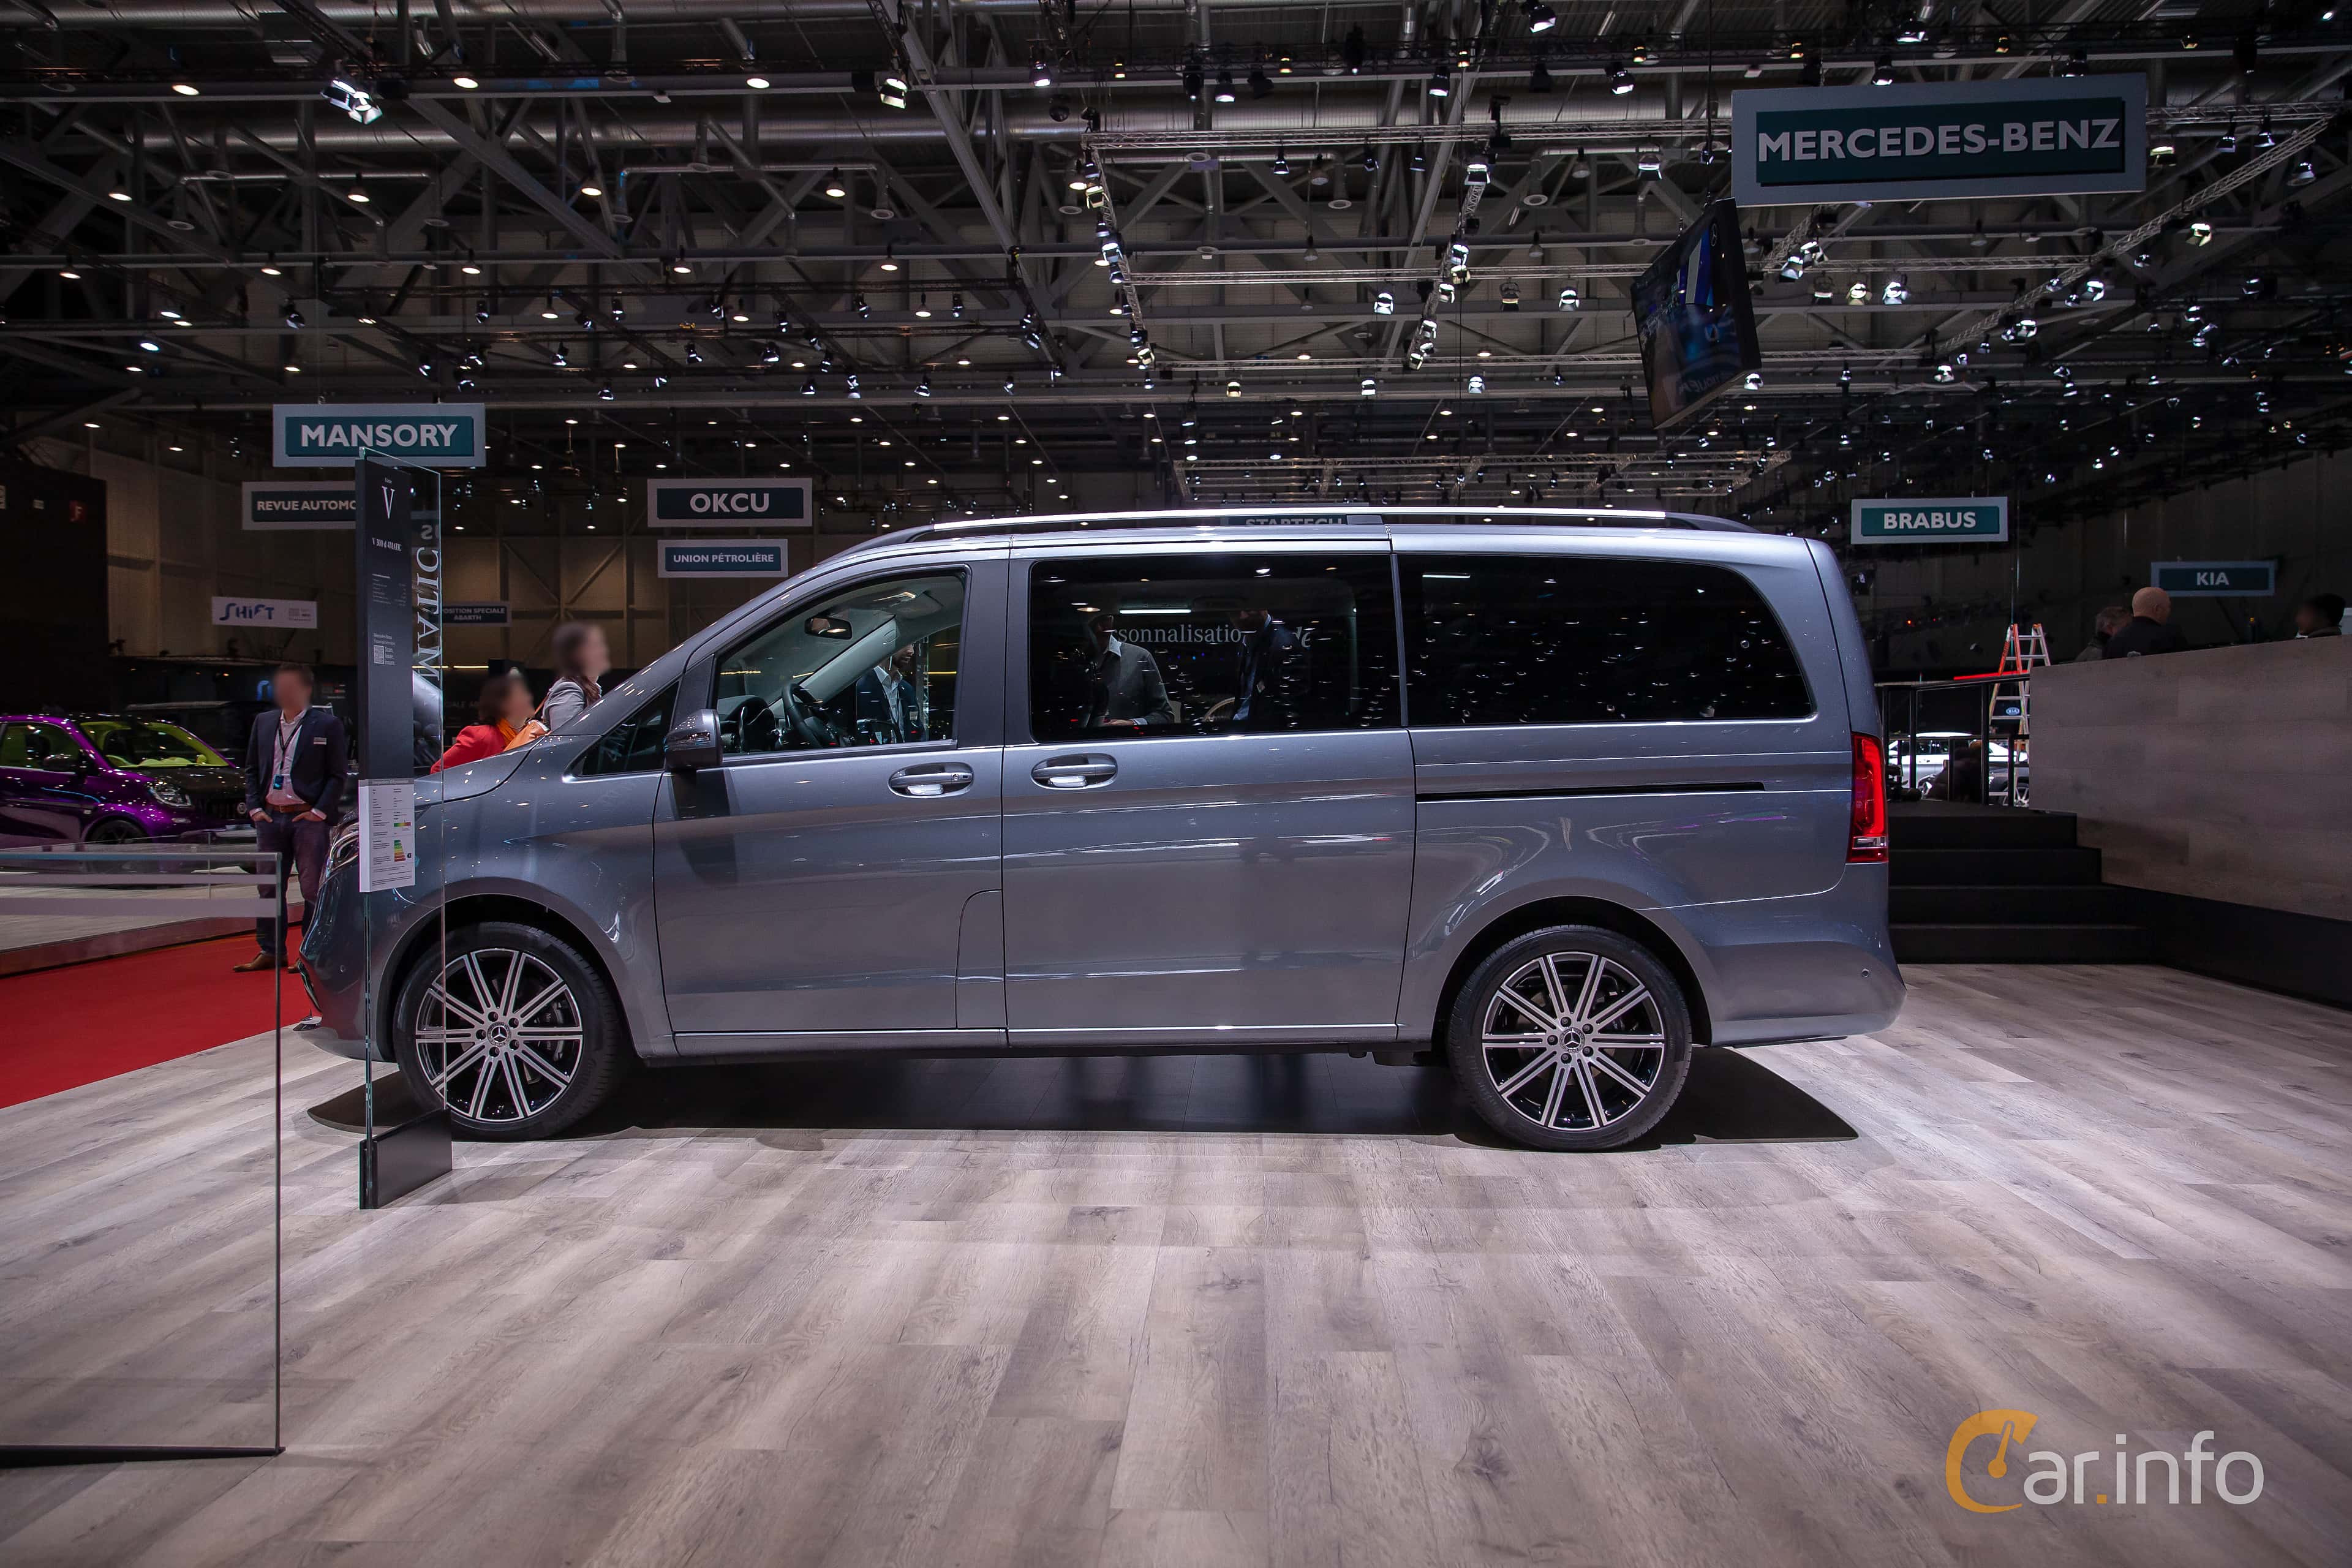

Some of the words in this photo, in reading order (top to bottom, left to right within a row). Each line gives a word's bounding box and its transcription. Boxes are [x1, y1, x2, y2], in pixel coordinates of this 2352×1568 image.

[1758, 118, 2120, 162] MERCEDES-BENZ
[301, 424, 458, 448] MANSORY
[257, 501, 299, 510] REVUE
[690, 493, 770, 513] OKCU
[1883, 511, 1977, 529] BRABUS
[673, 554, 709, 563] UNION
[712, 552, 774, 563] PÉTROLIÈRE
[2196, 572, 2230, 586] KIA
